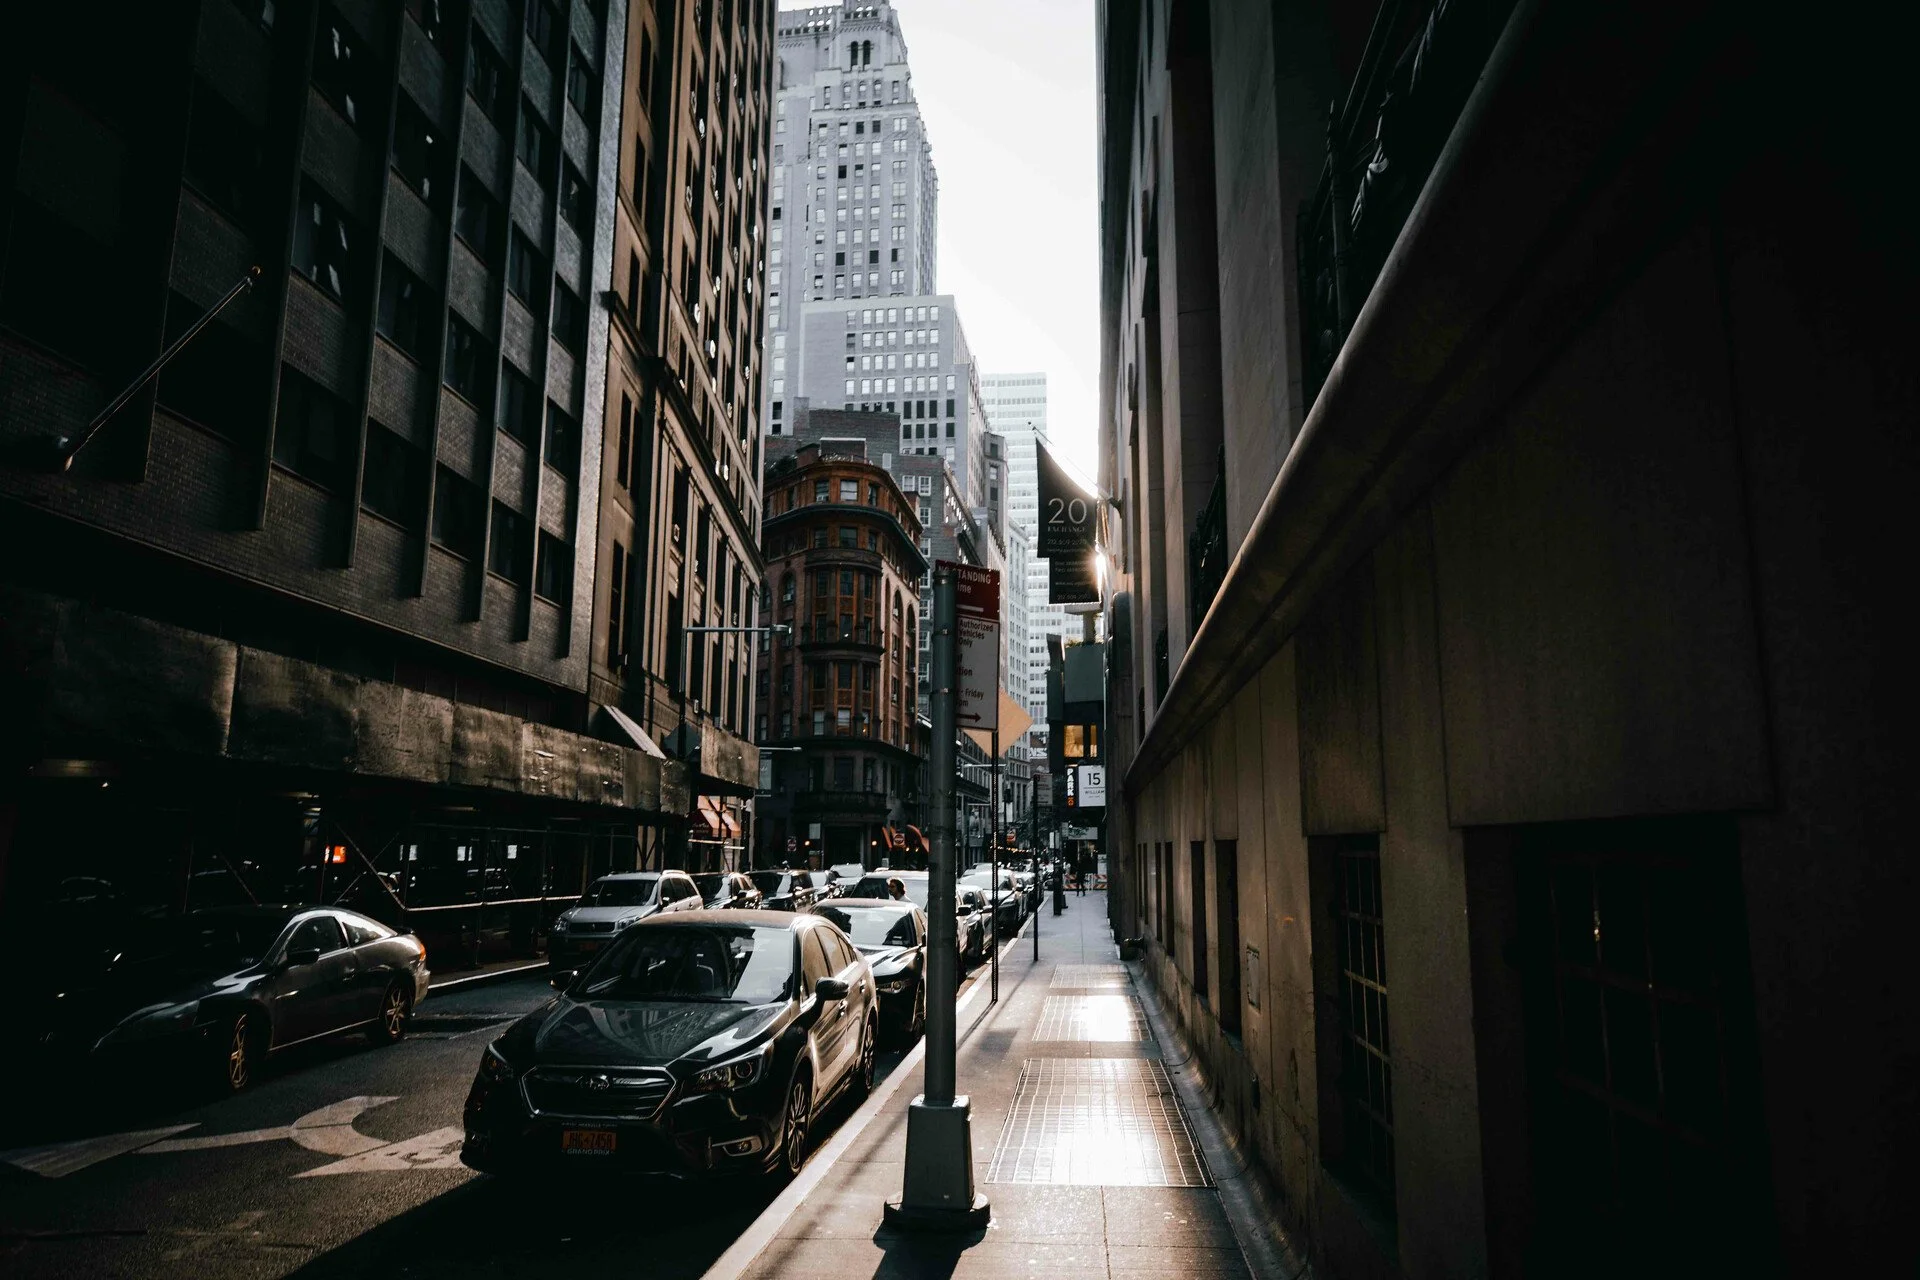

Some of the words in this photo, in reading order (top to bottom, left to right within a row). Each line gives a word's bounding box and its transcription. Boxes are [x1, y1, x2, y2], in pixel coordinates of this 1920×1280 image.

[1048, 497, 1087, 524] 20
[957, 569, 991, 585] TANDING
[957, 582, 972, 594] ime
[960, 619, 994, 632] Authorized
[959, 629, 985, 639] Vehicles
[958, 638, 973, 648] Only
[965, 688, 985, 701] Friday
[1067, 768, 1075, 796] PARK
[1087, 772, 1101, 786] 15
